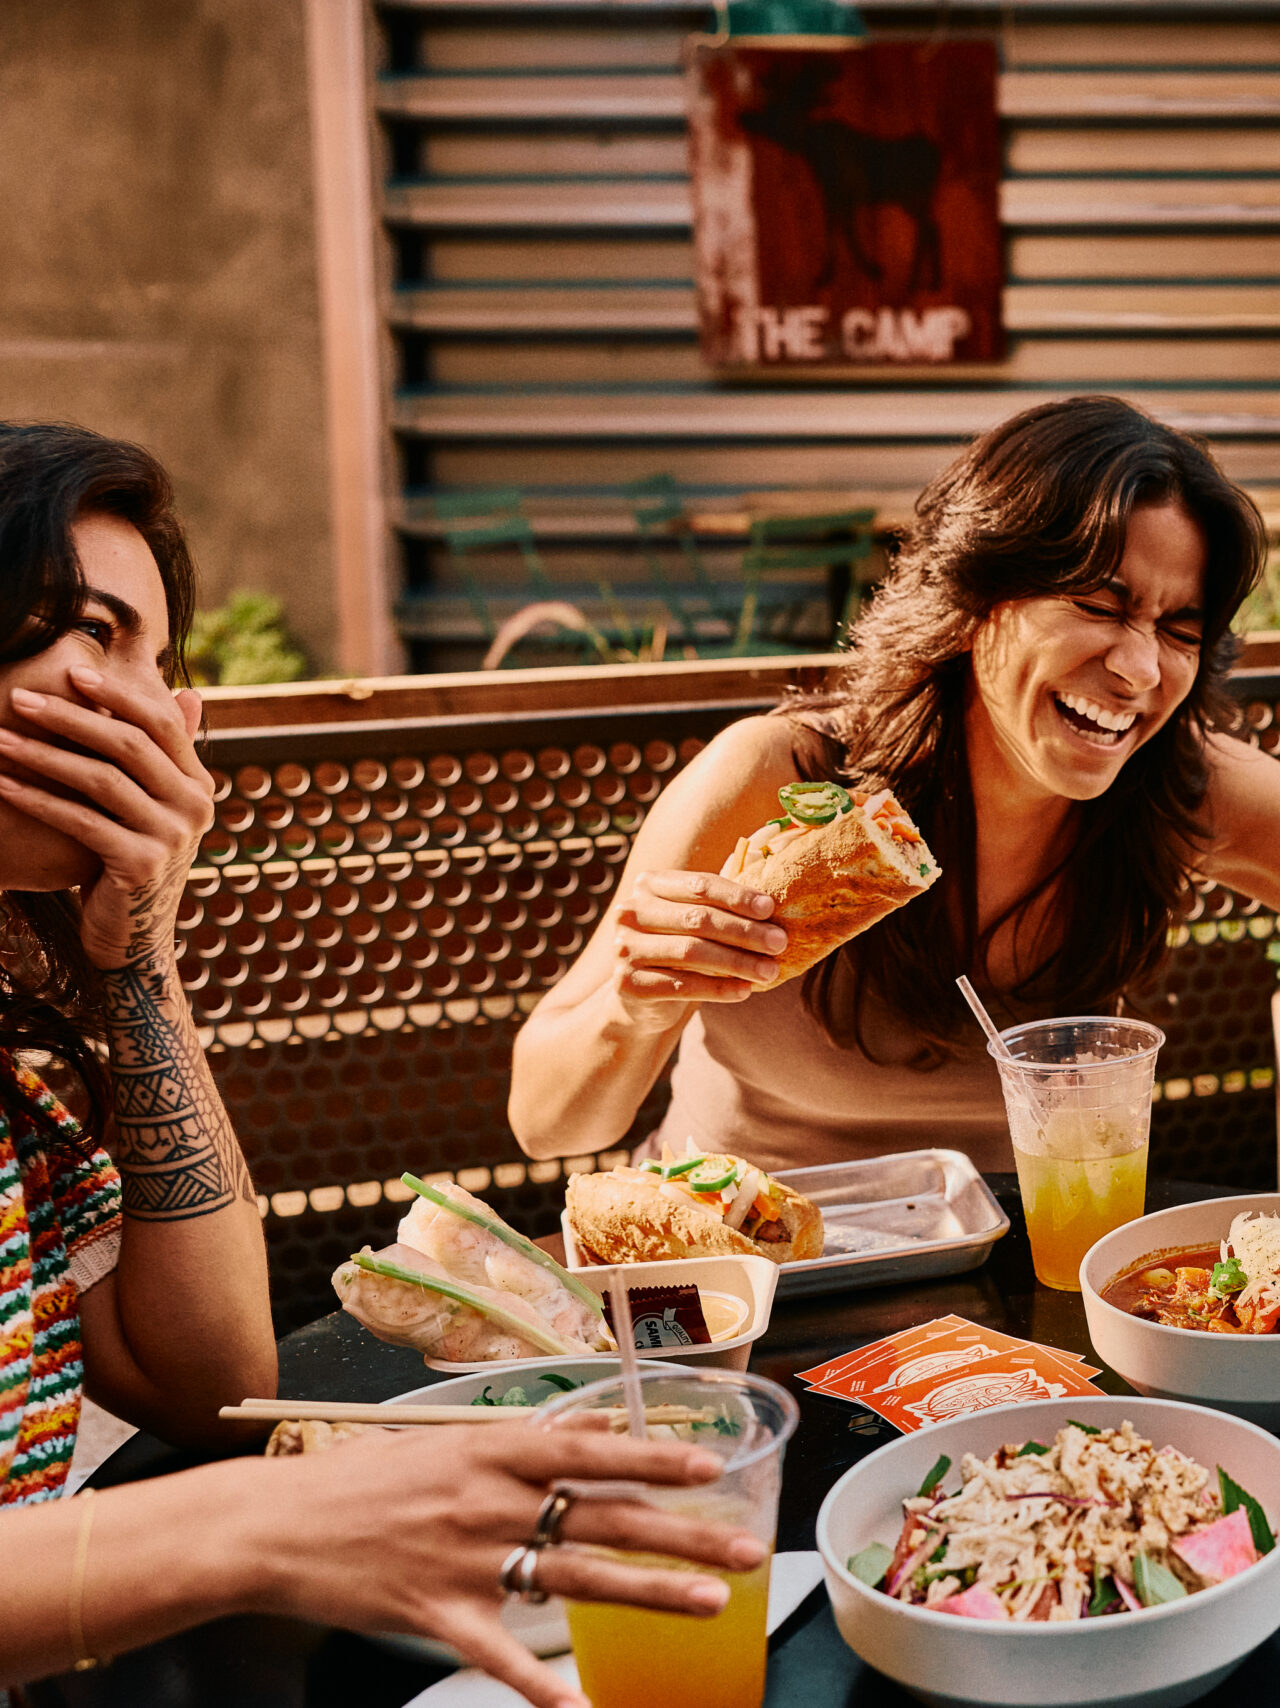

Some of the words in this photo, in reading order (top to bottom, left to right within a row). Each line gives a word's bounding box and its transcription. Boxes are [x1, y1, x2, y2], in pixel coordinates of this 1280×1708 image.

[738, 306, 826, 360] THE
[842, 305, 972, 360] CAMP
[672, 1324, 691, 1345] QUALITY
